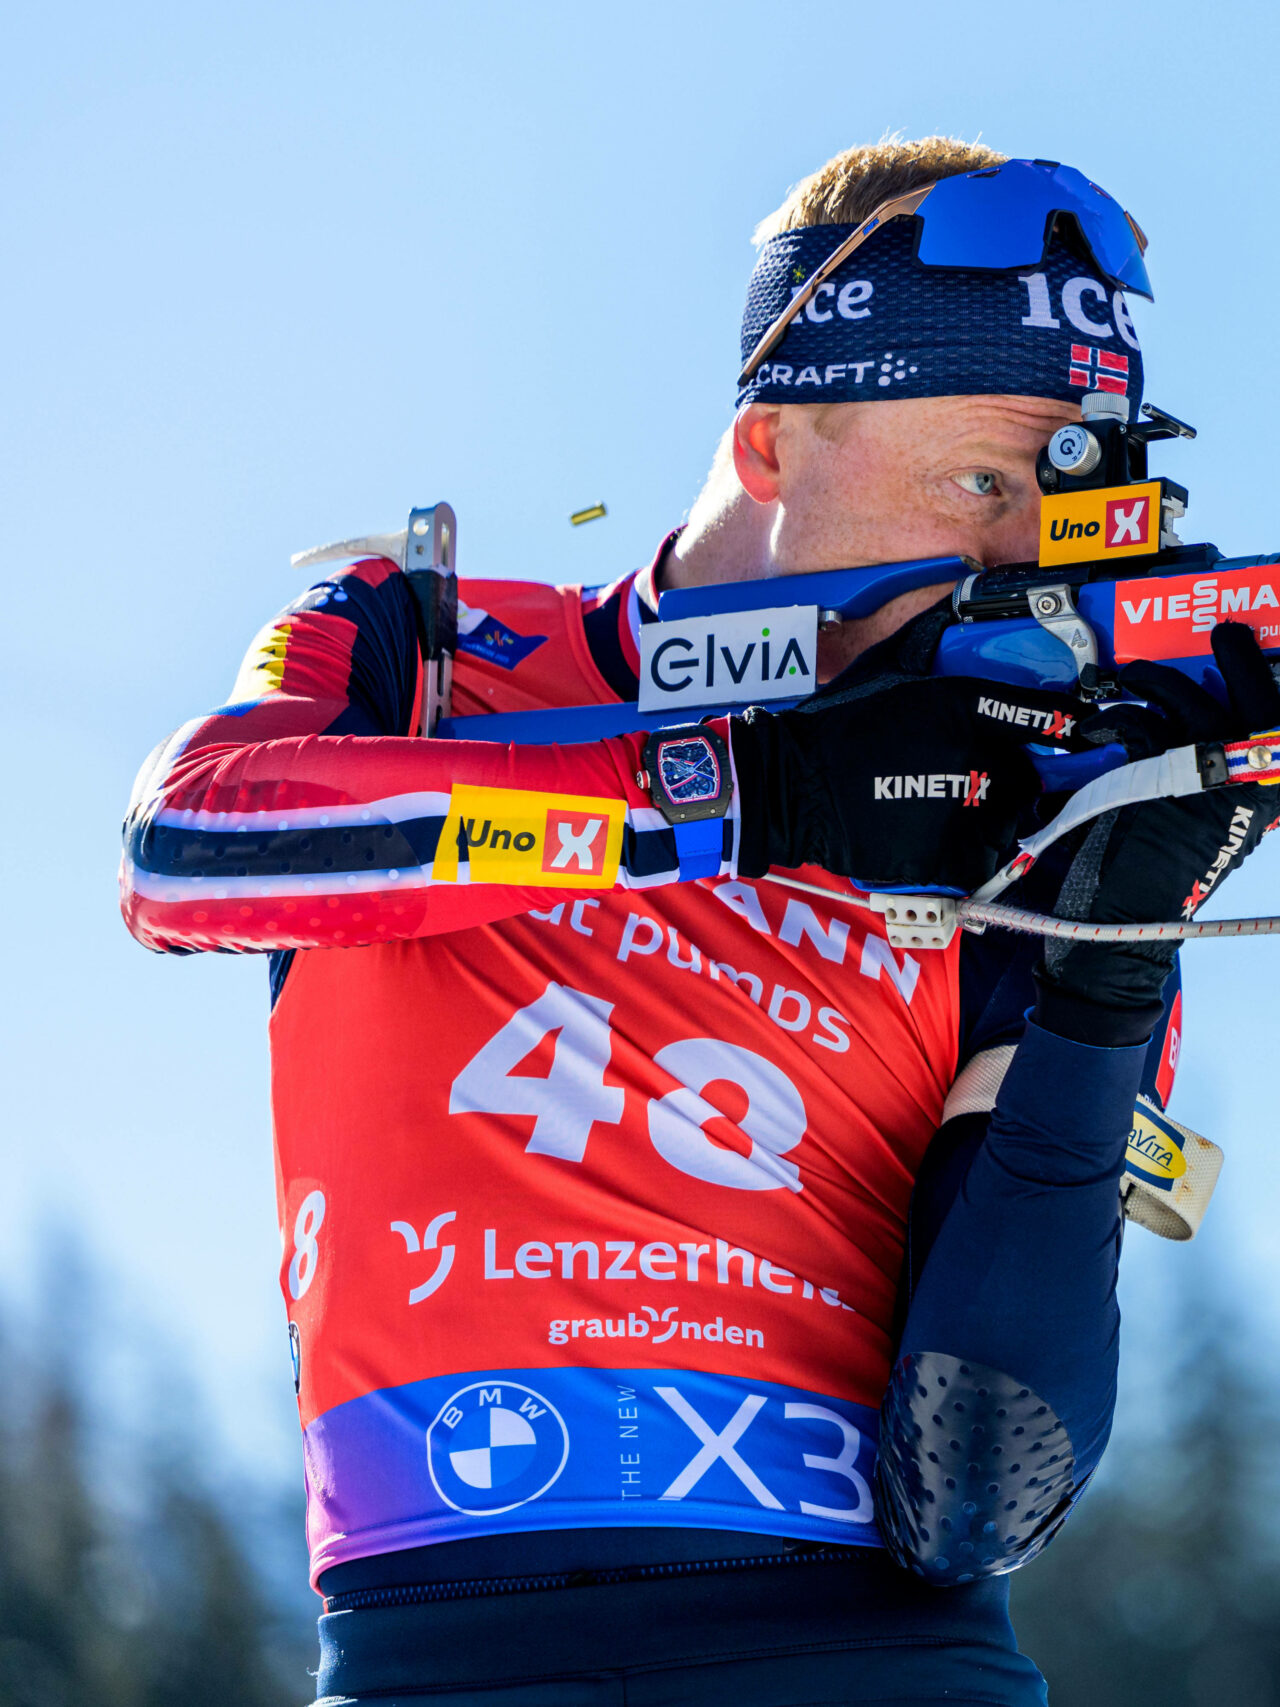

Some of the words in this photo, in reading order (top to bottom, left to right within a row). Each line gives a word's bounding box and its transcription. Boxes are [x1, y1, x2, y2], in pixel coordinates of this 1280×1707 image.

[1018, 272, 1140, 351] ice
[755, 361, 875, 387] CRAFT
[1050, 518, 1100, 541] Uno
[1110, 500, 1146, 544] X
[456, 818, 536, 852] Uno
[550, 819, 603, 870] X
[617, 912, 851, 1053] pumps
[442, 1387, 547, 1430] BMW
[616, 1385, 639, 1438] NEW
[620, 1453, 642, 1501] THE
[652, 1386, 874, 1524] X3
